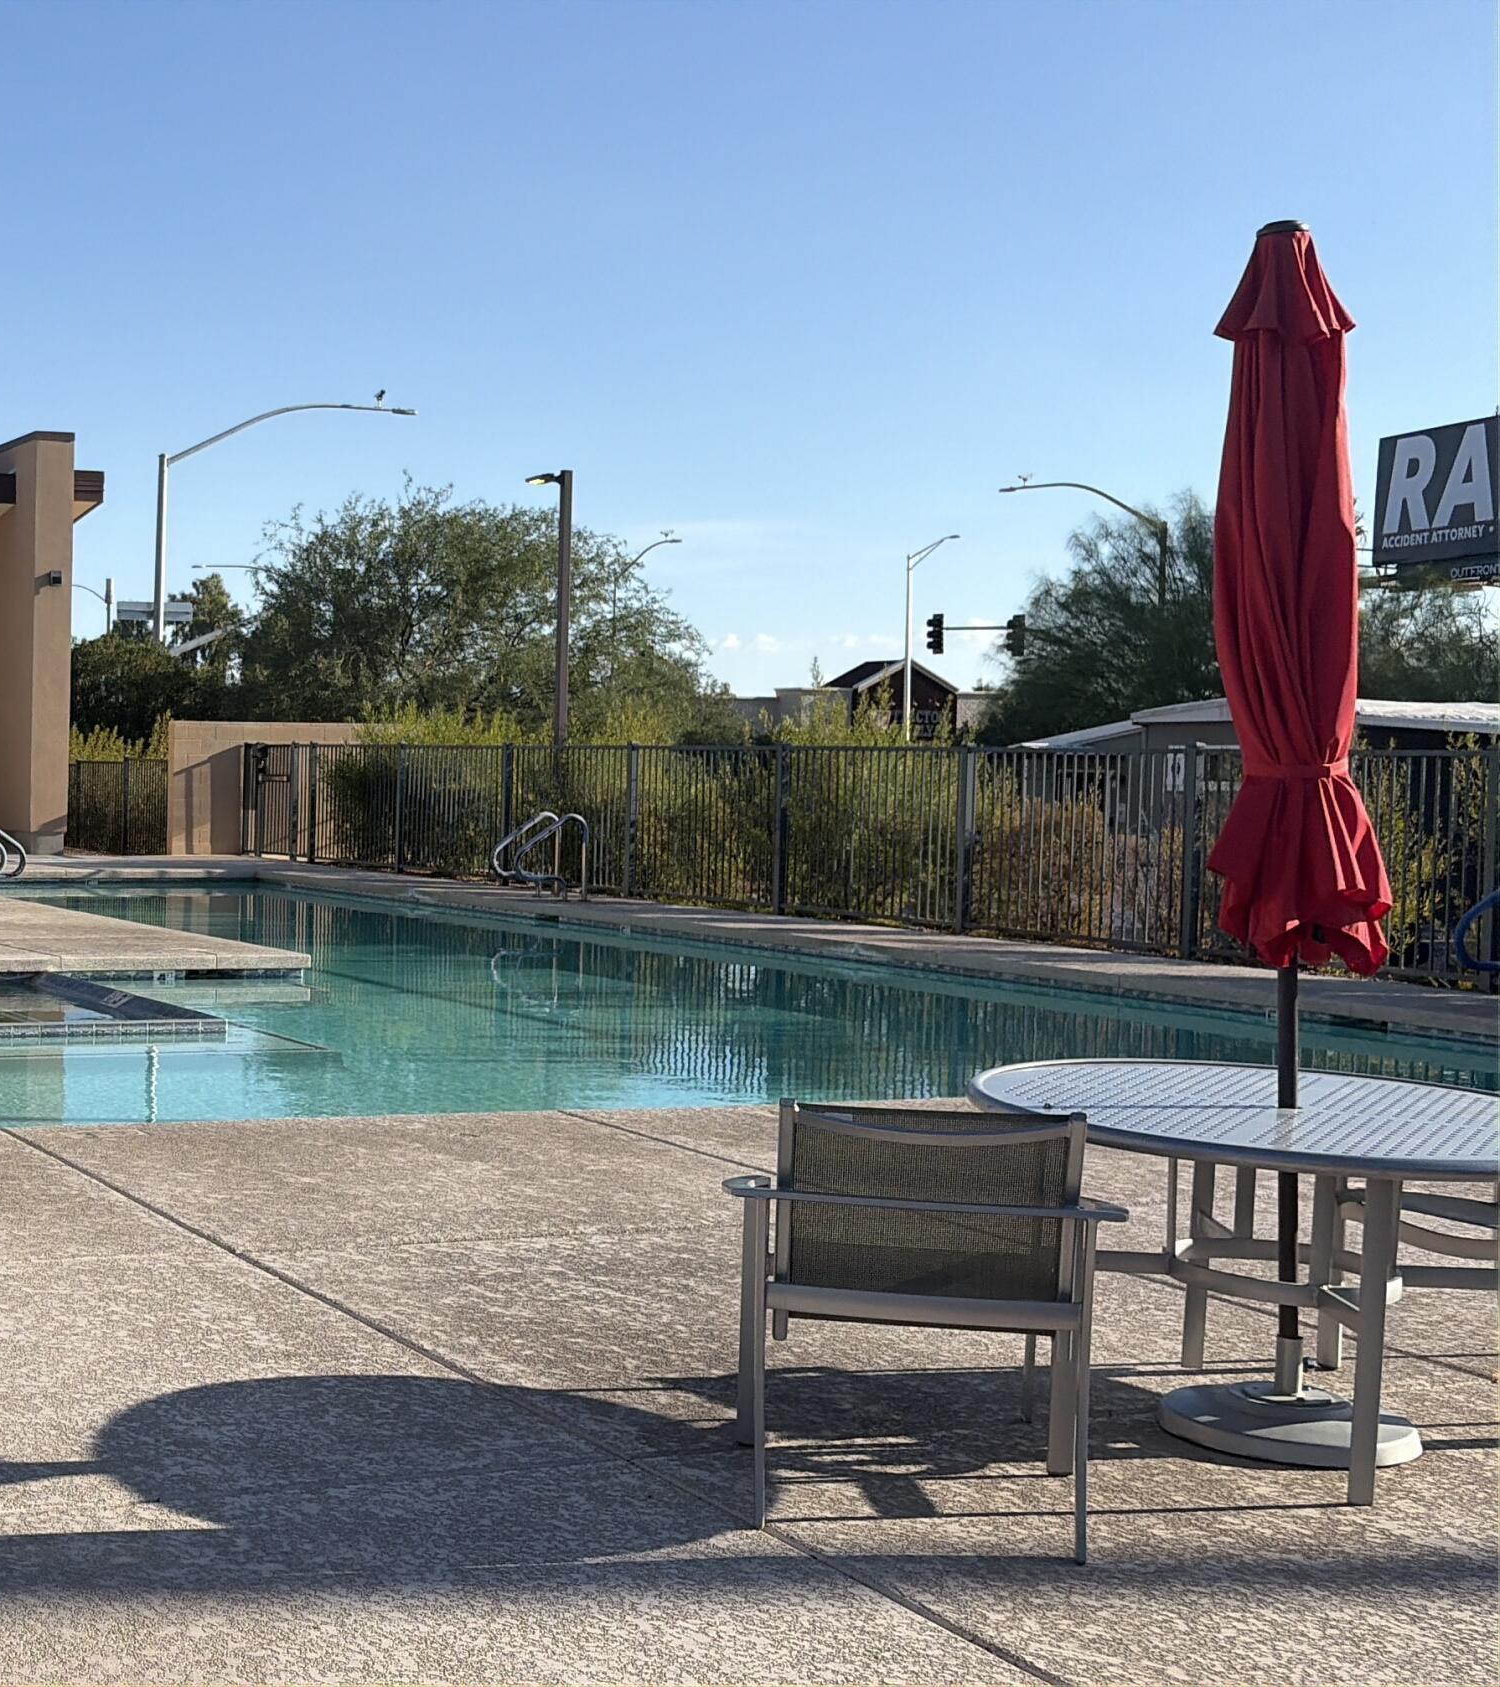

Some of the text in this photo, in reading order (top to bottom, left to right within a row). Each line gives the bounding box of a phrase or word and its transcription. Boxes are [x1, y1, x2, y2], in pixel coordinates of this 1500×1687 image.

[1382, 423, 1494, 534] RA
[1382, 524, 1485, 549] ACCIDENT ATTORNEY
